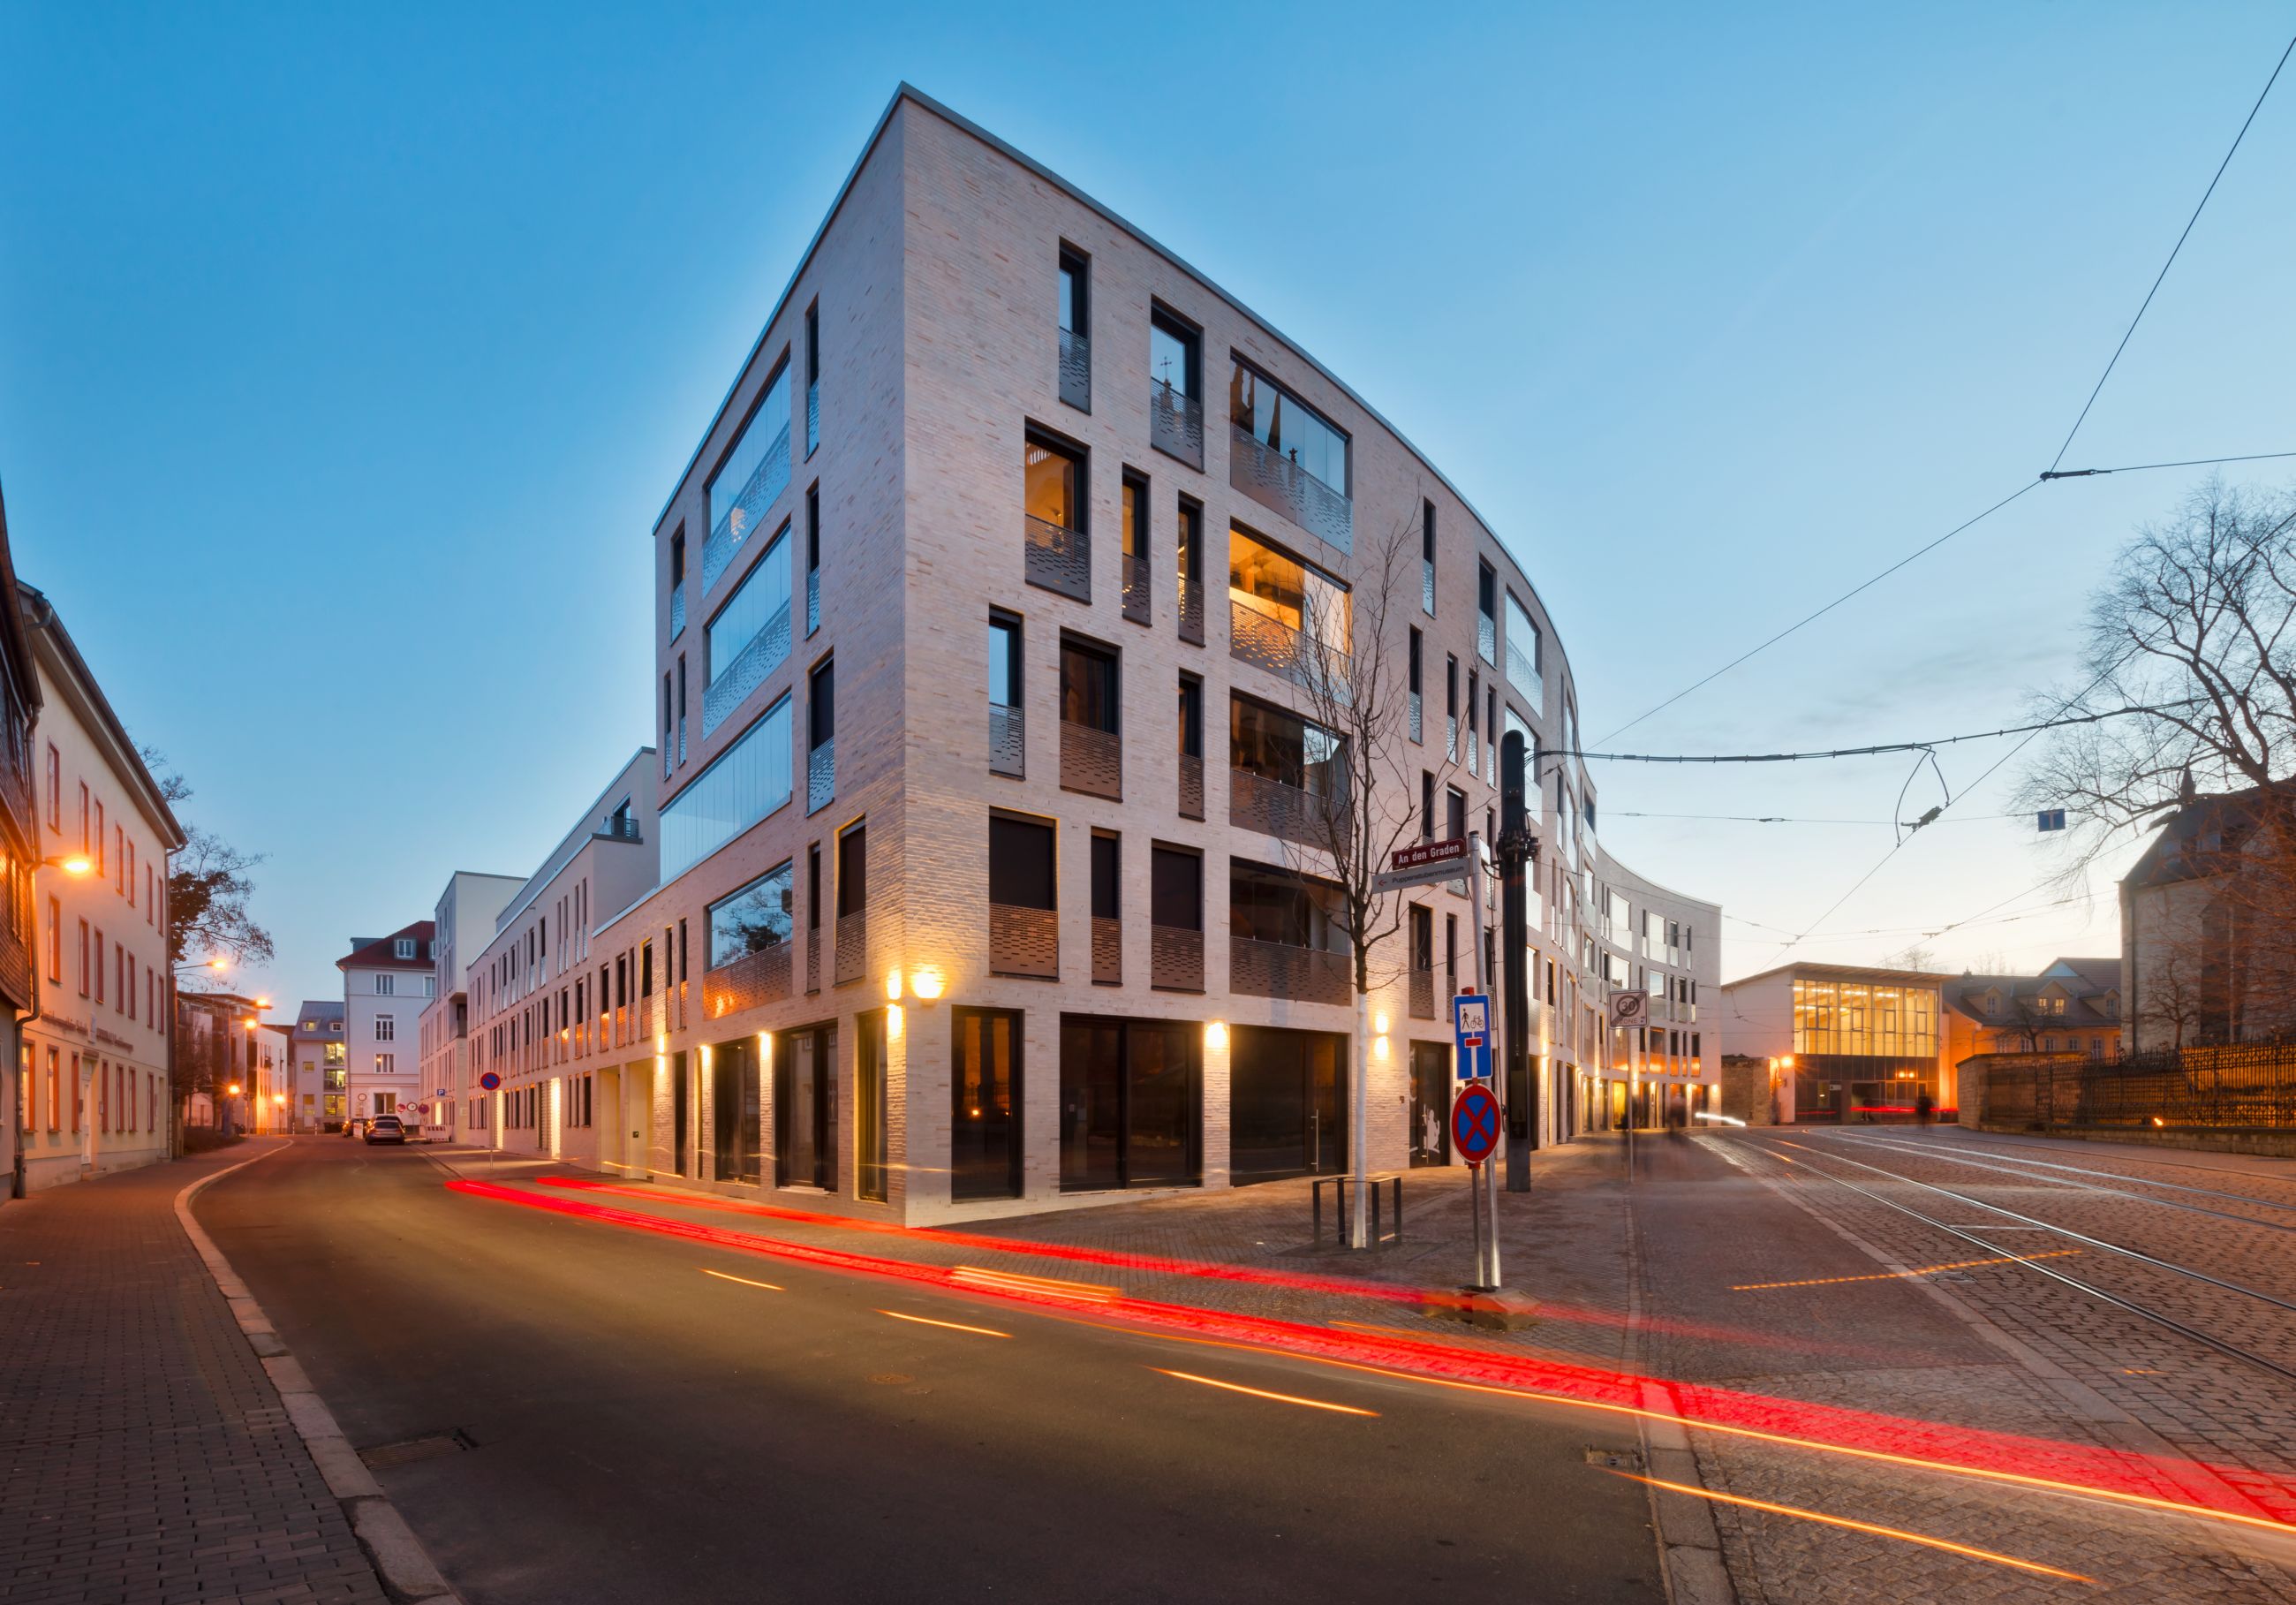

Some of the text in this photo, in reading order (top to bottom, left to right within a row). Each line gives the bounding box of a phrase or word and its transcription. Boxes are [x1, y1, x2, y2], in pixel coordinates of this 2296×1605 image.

[1398, 844, 1460, 865] An den Graden
[1621, 1000, 1635, 1011] 30
